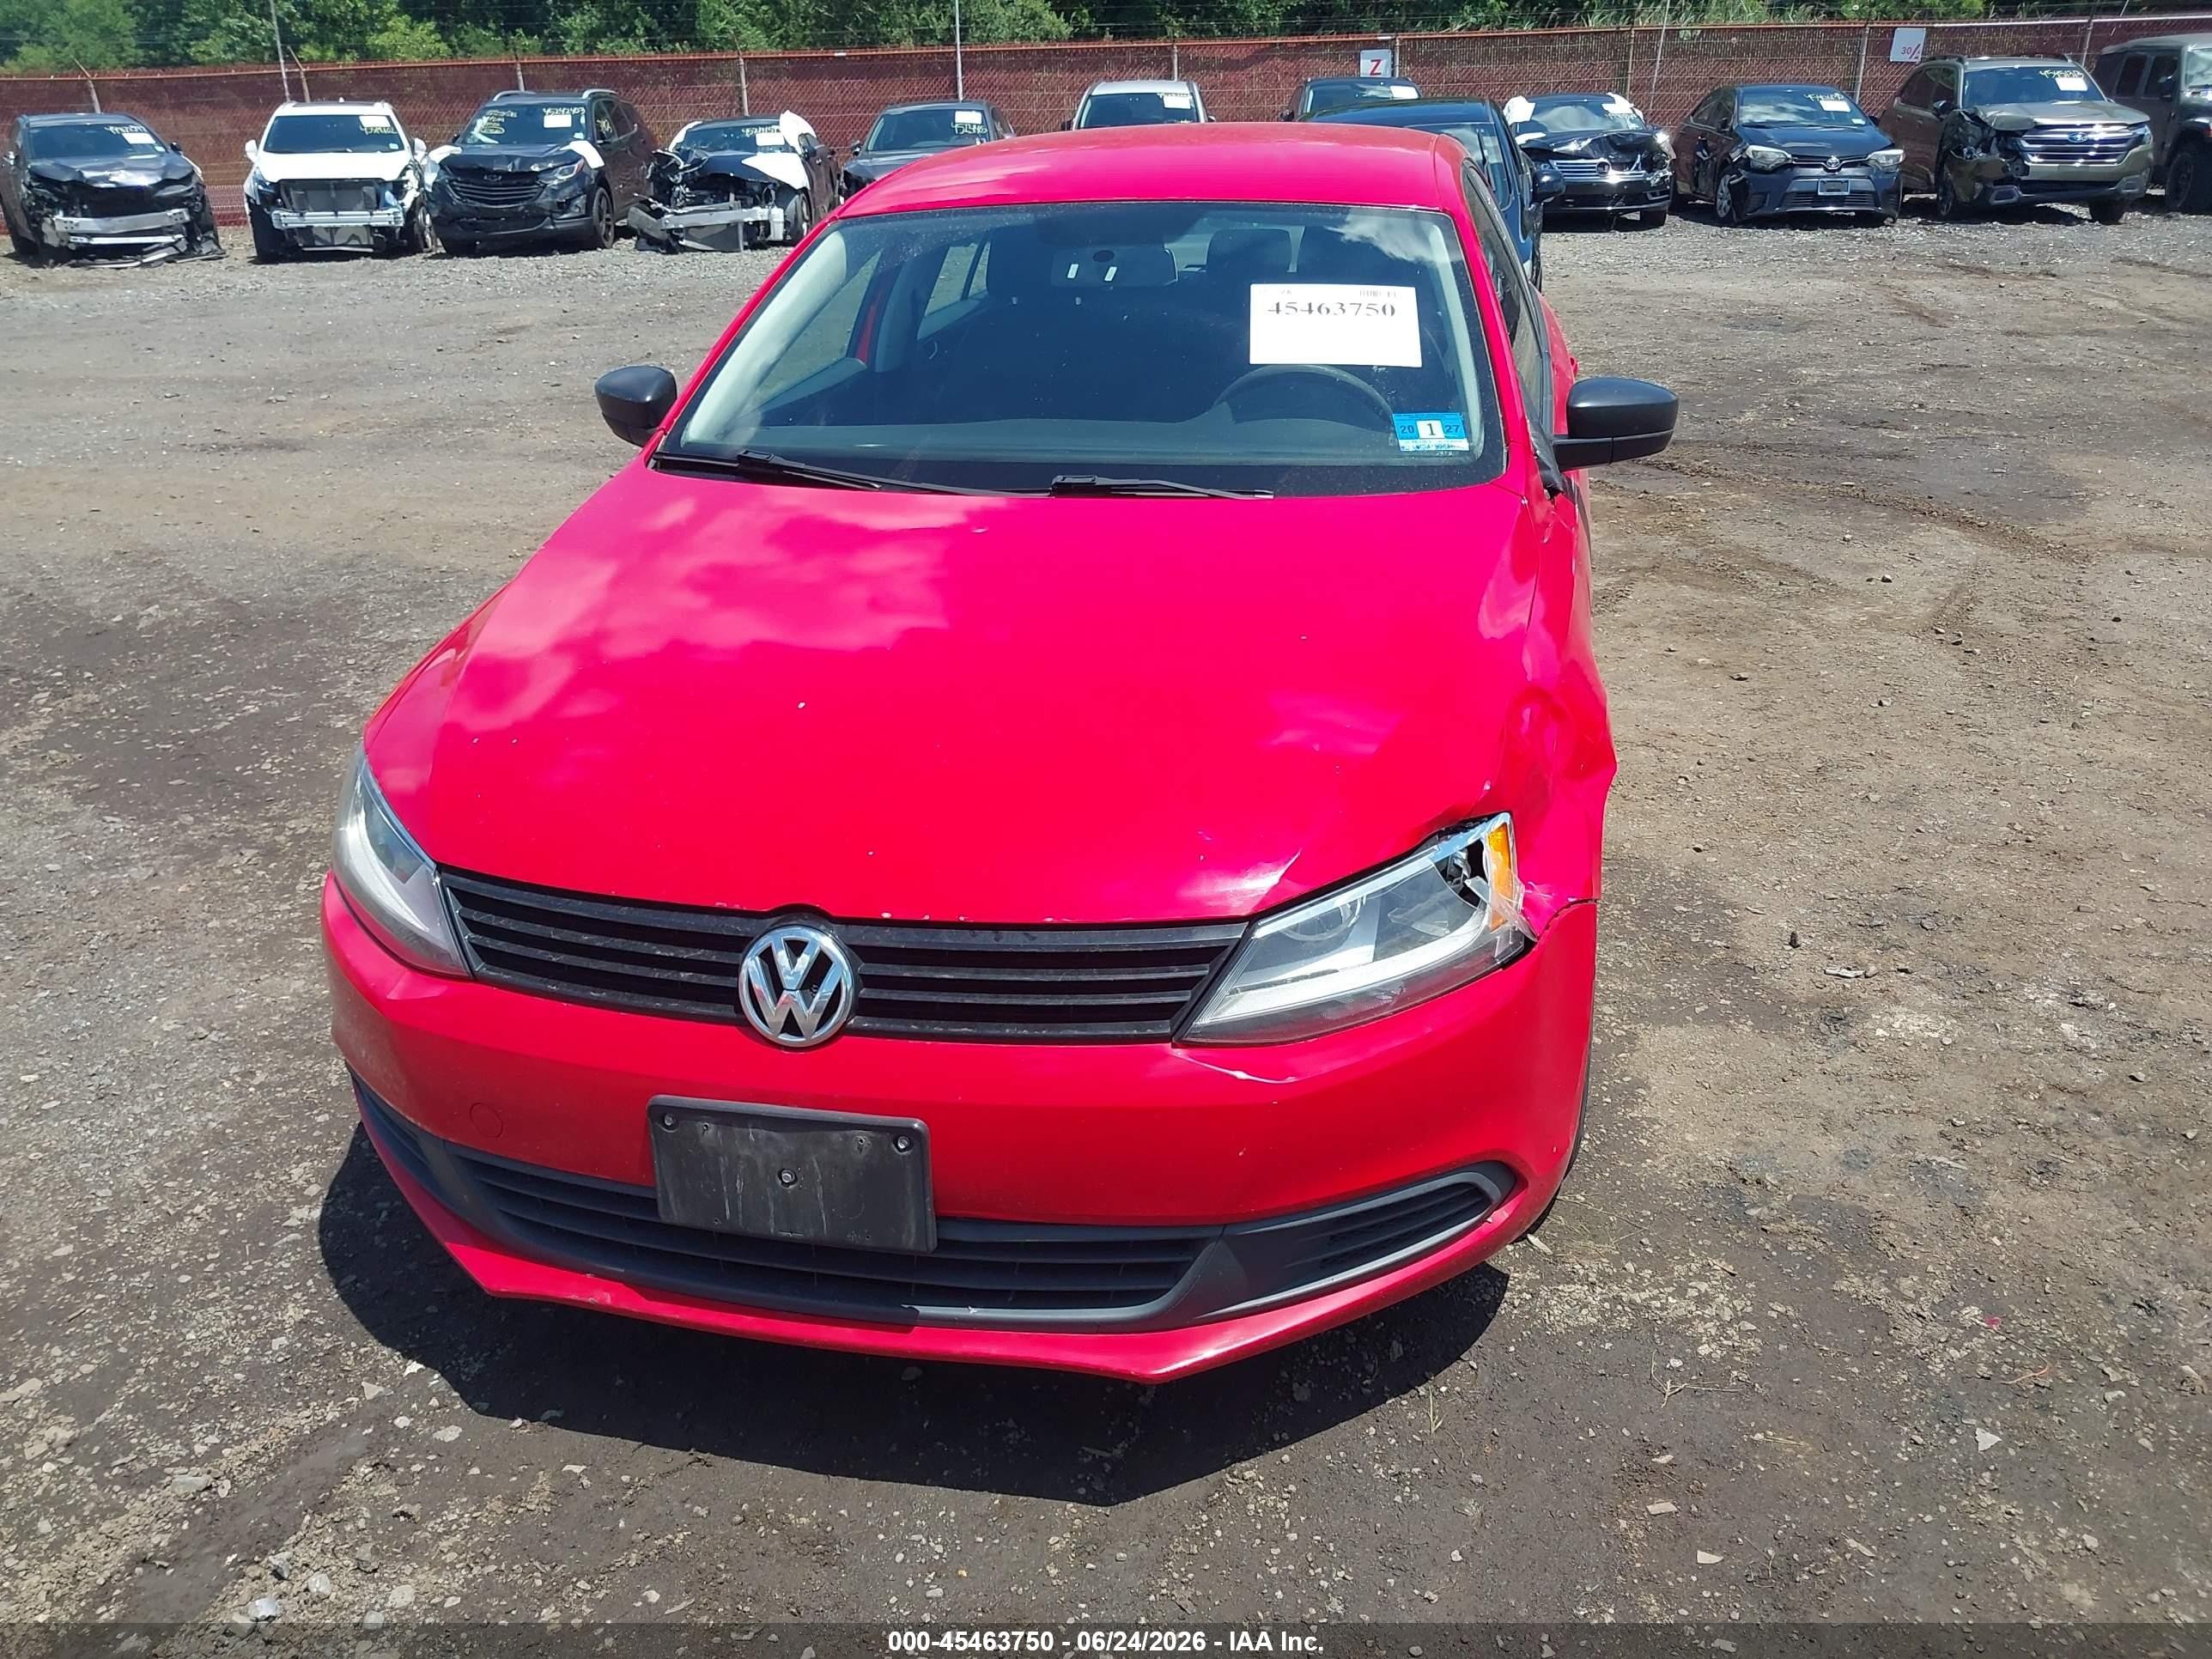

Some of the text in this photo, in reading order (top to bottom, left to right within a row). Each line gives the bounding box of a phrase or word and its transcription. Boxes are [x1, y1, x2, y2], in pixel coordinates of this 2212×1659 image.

[1370, 58, 1382, 76] Z
[1267, 301, 1395, 317] 45463750
[1400, 422, 1461, 436] 20 1 27
